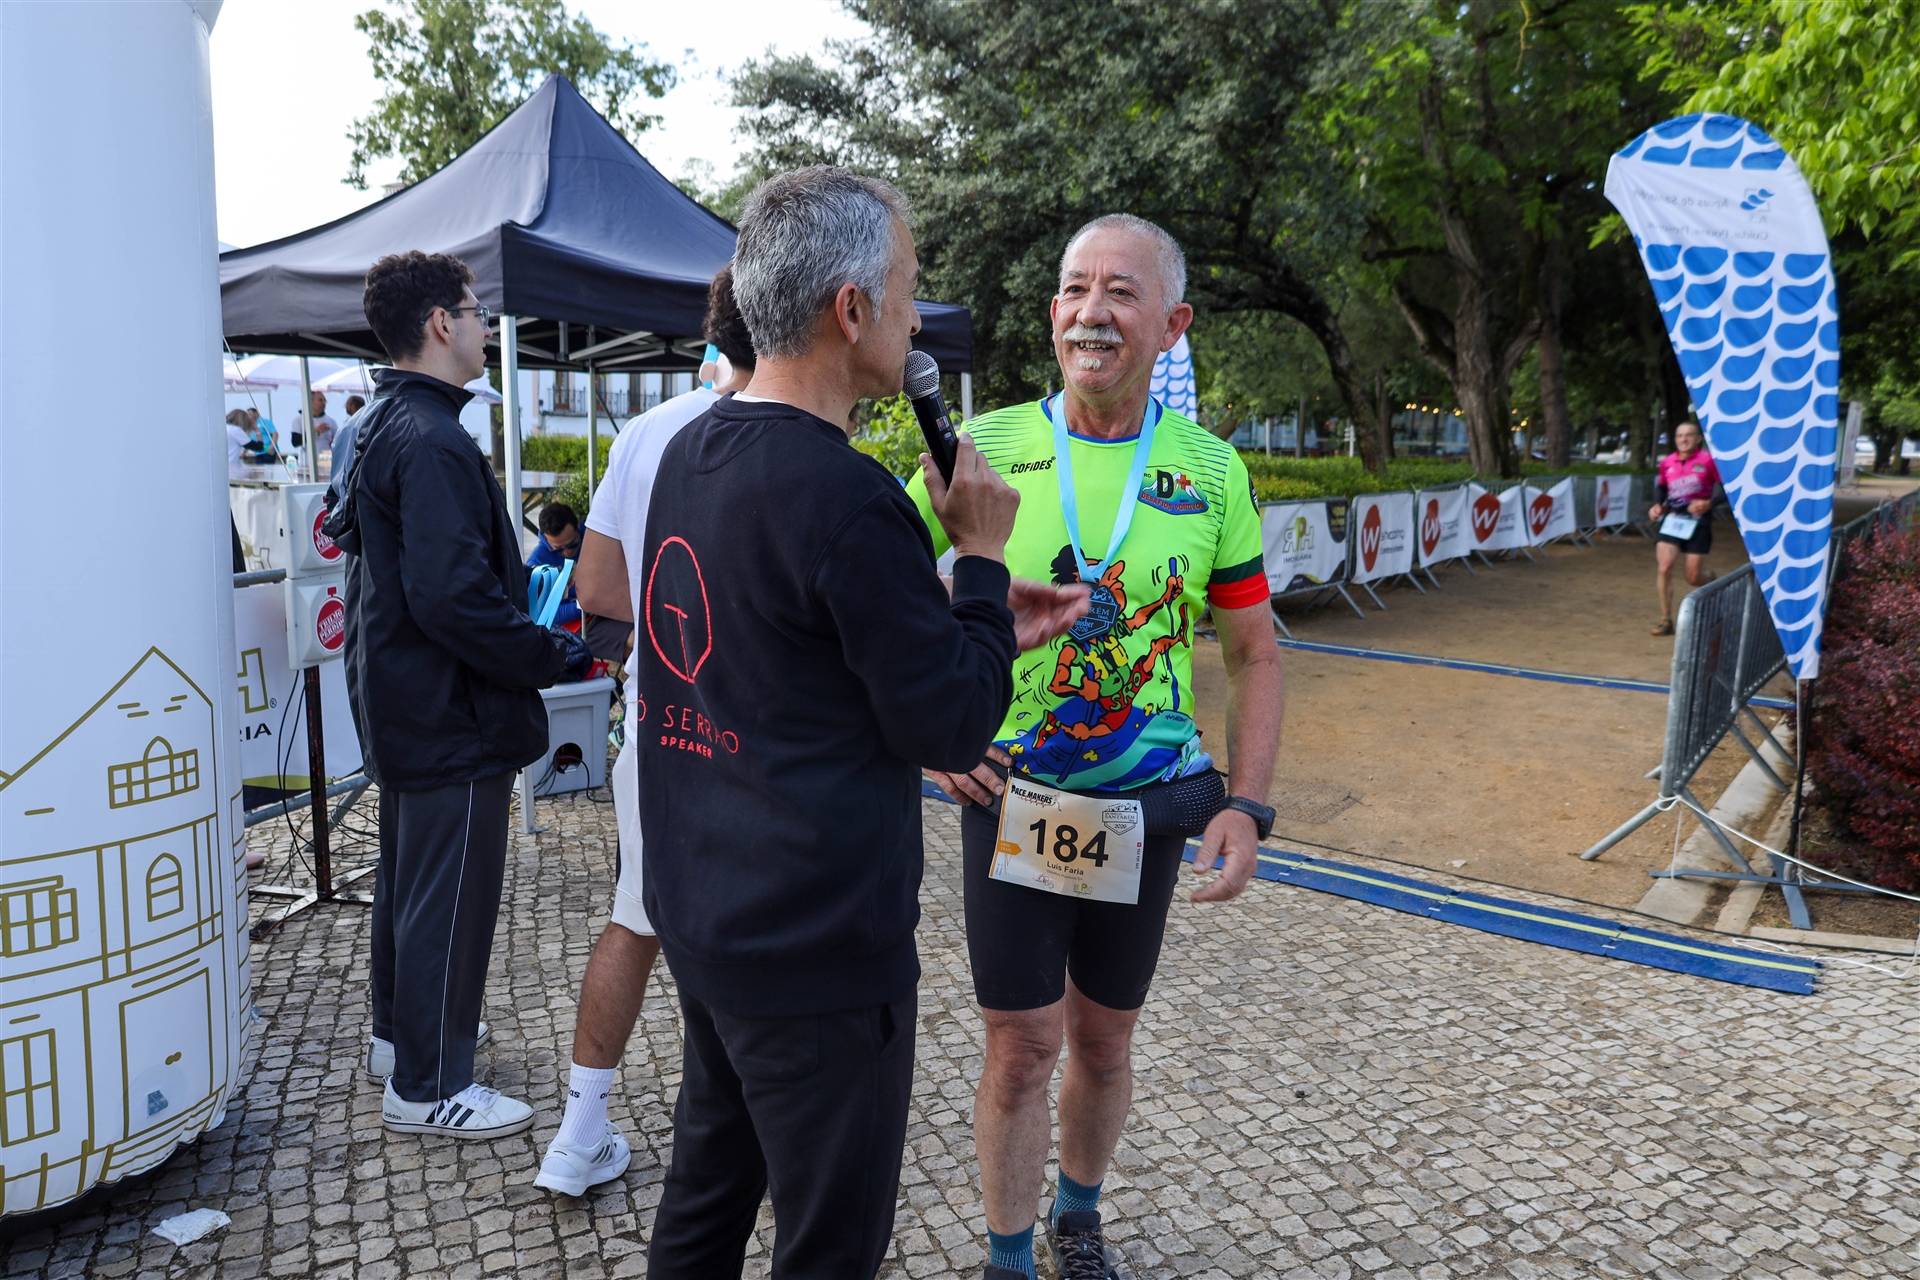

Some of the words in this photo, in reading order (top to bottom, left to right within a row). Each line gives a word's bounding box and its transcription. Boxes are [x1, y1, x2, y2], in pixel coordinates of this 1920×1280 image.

[1141, 491, 1172, 510] DESAFIOS
[1174, 502, 1205, 511] POSITIVOS
[660, 735, 713, 760] SPEAKER
[1027, 791, 1053, 804] MAKERS
[1029, 818, 1109, 868] 184
[1064, 866, 1084, 876] Faria
